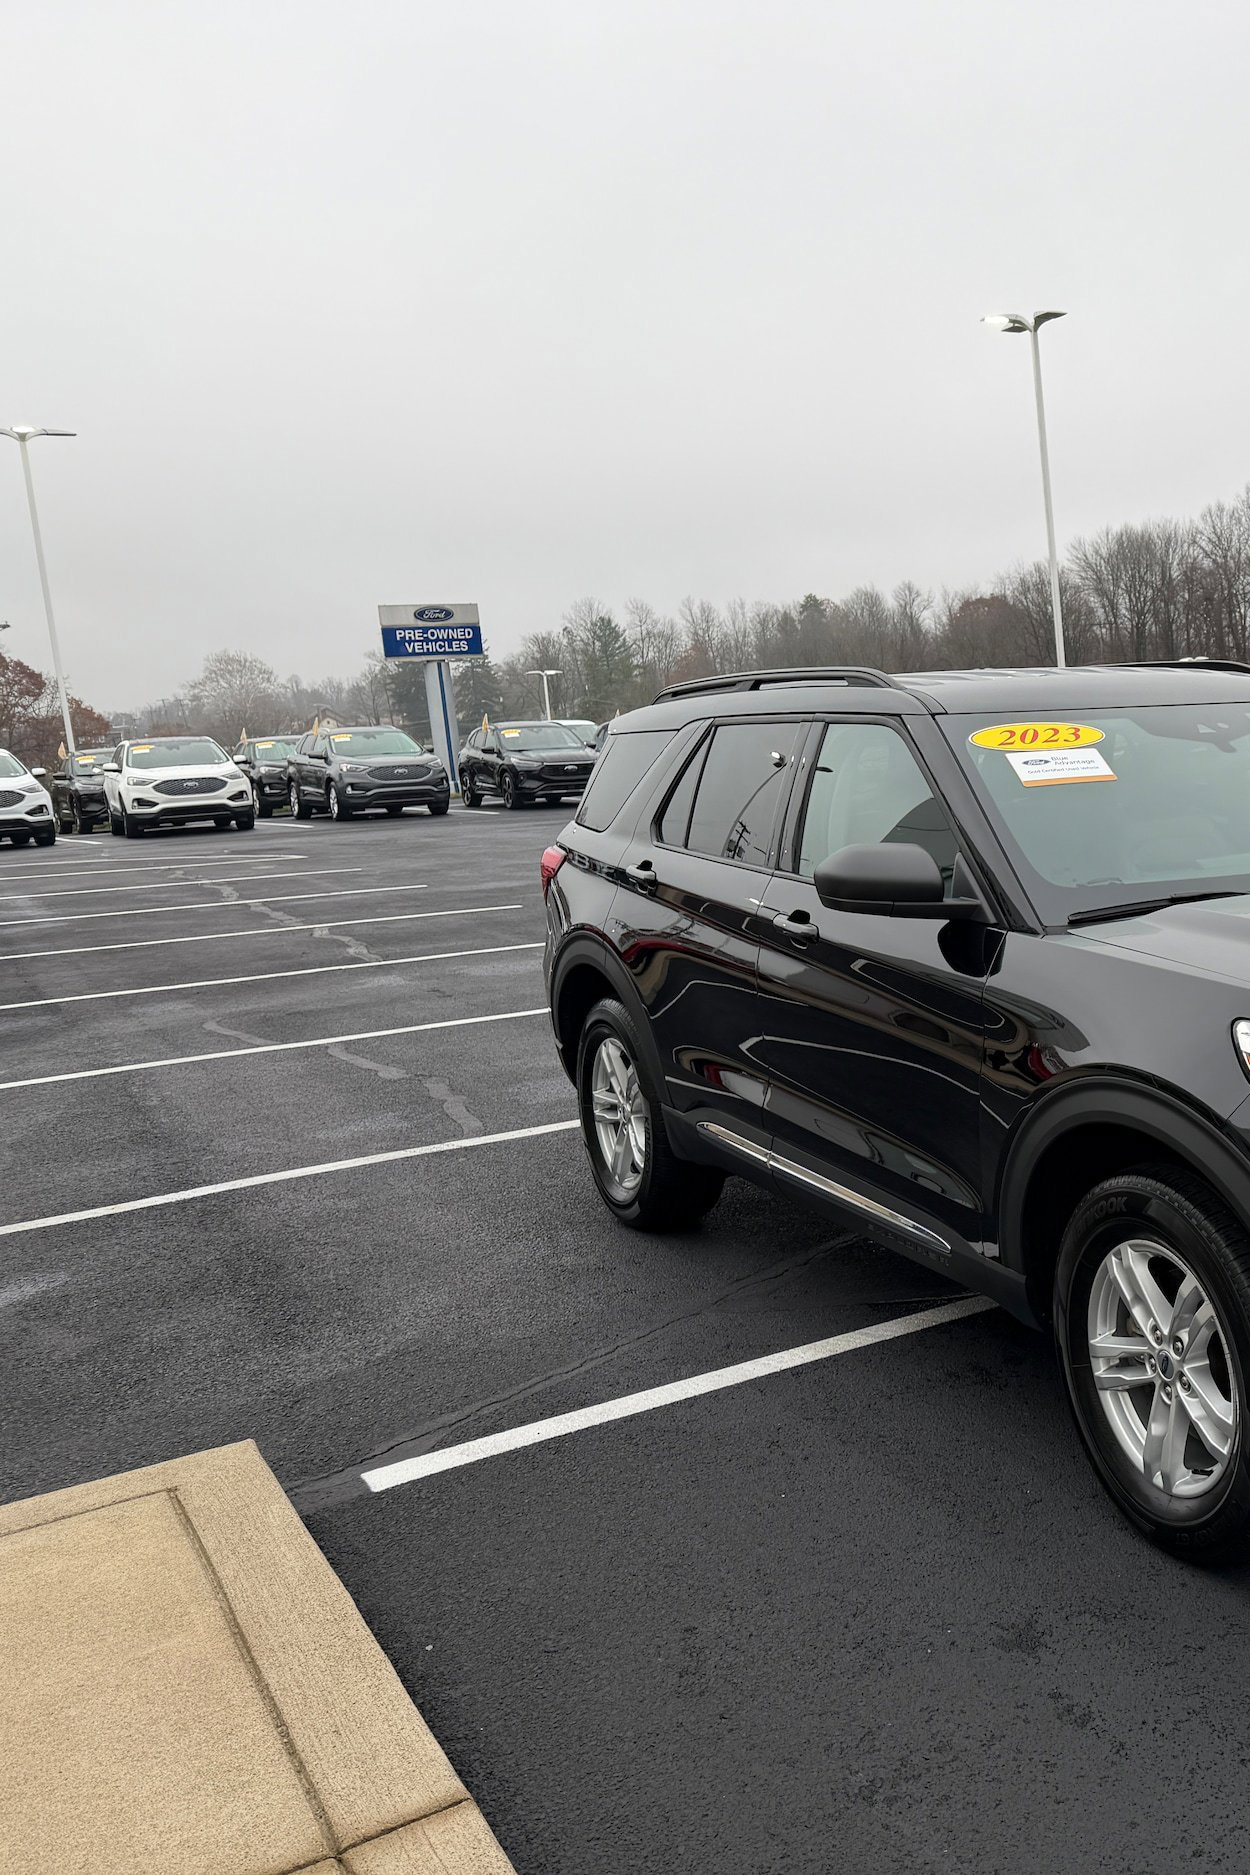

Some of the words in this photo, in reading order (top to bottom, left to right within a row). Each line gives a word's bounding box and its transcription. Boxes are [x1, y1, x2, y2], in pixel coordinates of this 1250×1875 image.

[396, 628, 473, 641] PRE-OWNED
[405, 641, 468, 653] VEHICLES
[997, 727, 1081, 746] 2023
